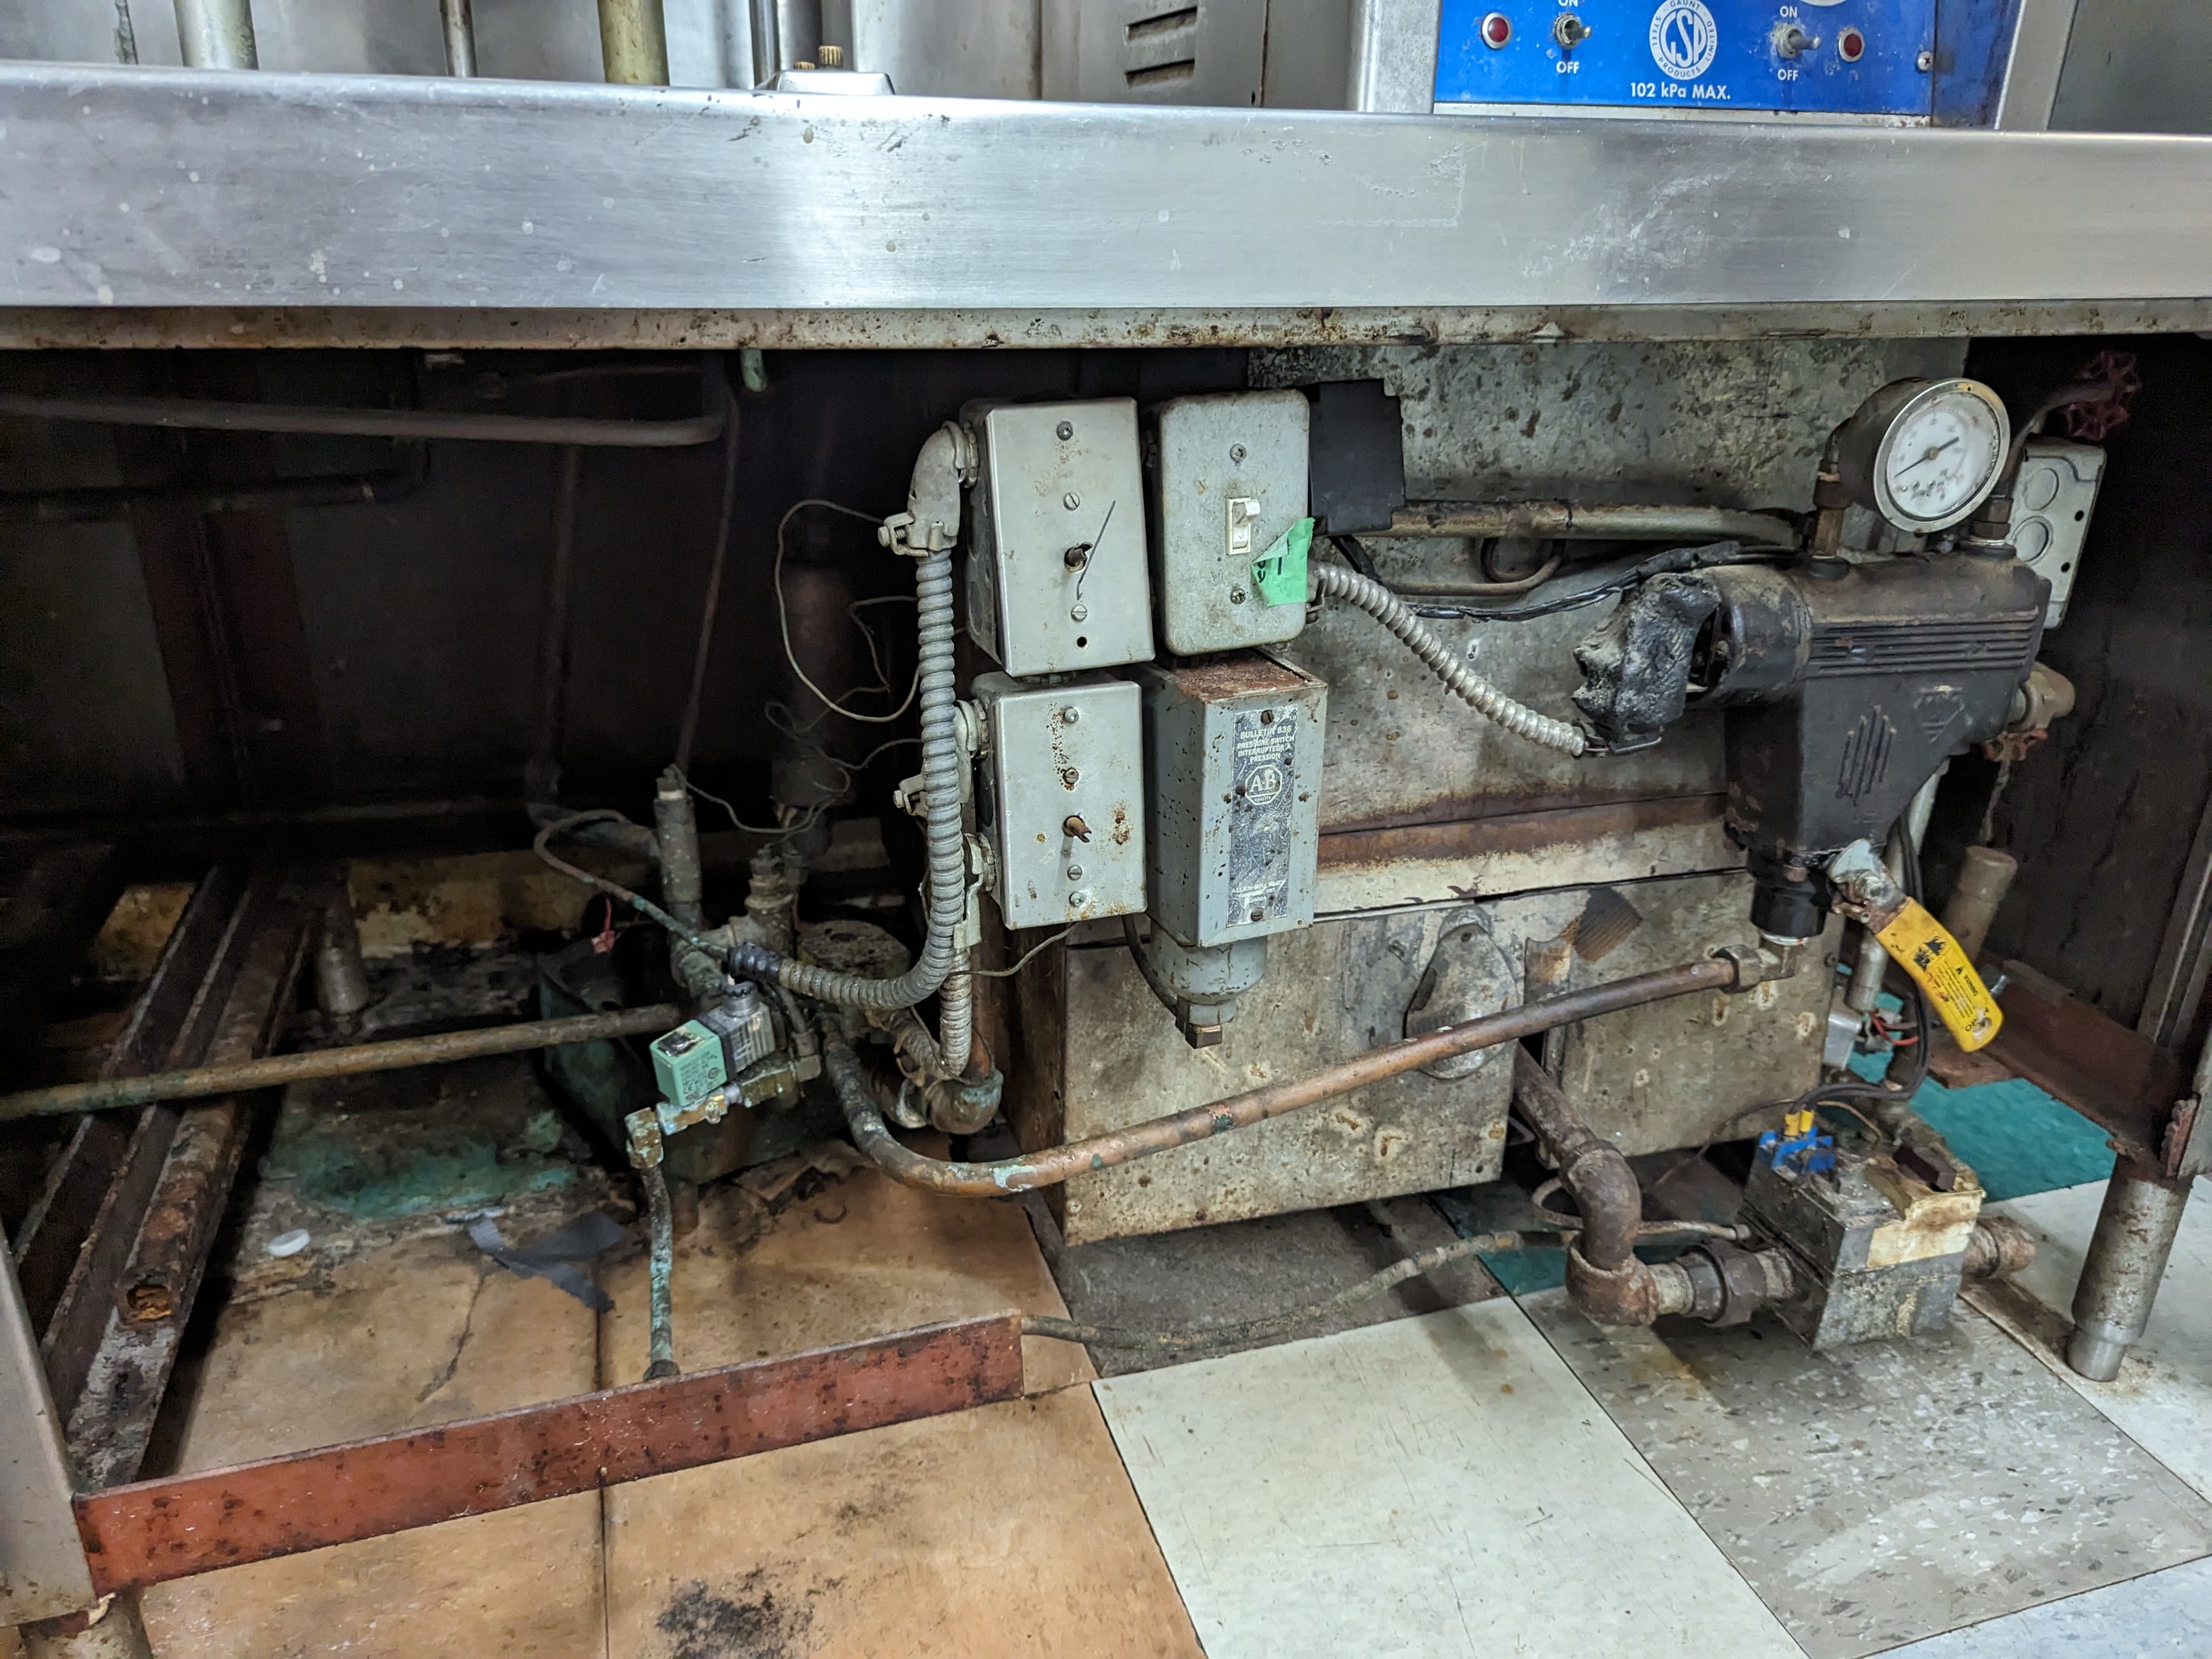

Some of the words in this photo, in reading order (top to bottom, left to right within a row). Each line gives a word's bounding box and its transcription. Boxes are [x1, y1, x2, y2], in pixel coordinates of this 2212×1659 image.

[1669, 0, 1700, 10] GAUNT
[1780, 5, 1798, 18] ON
[1651, 16, 1662, 47] STEEL
[1705, 21, 1715, 61] LIMITED
[1555, 60, 1580, 74] OFF
[1657, 56, 1701, 78] PRODUCTS
[1777, 68, 1799, 81] OFF
[1630, 82, 1656, 98] 102
[1661, 81, 1687, 98] kPa
[1692, 84, 1731, 100] MAX.
[1240, 728, 1274, 740] BULLETIN
[1277, 725, 1292, 734] 836
[1270, 735, 1295, 746] SWITCH
[1237, 744, 1285, 758] INTERRUPTEUR
[1249, 753, 1281, 763] PRESSION
